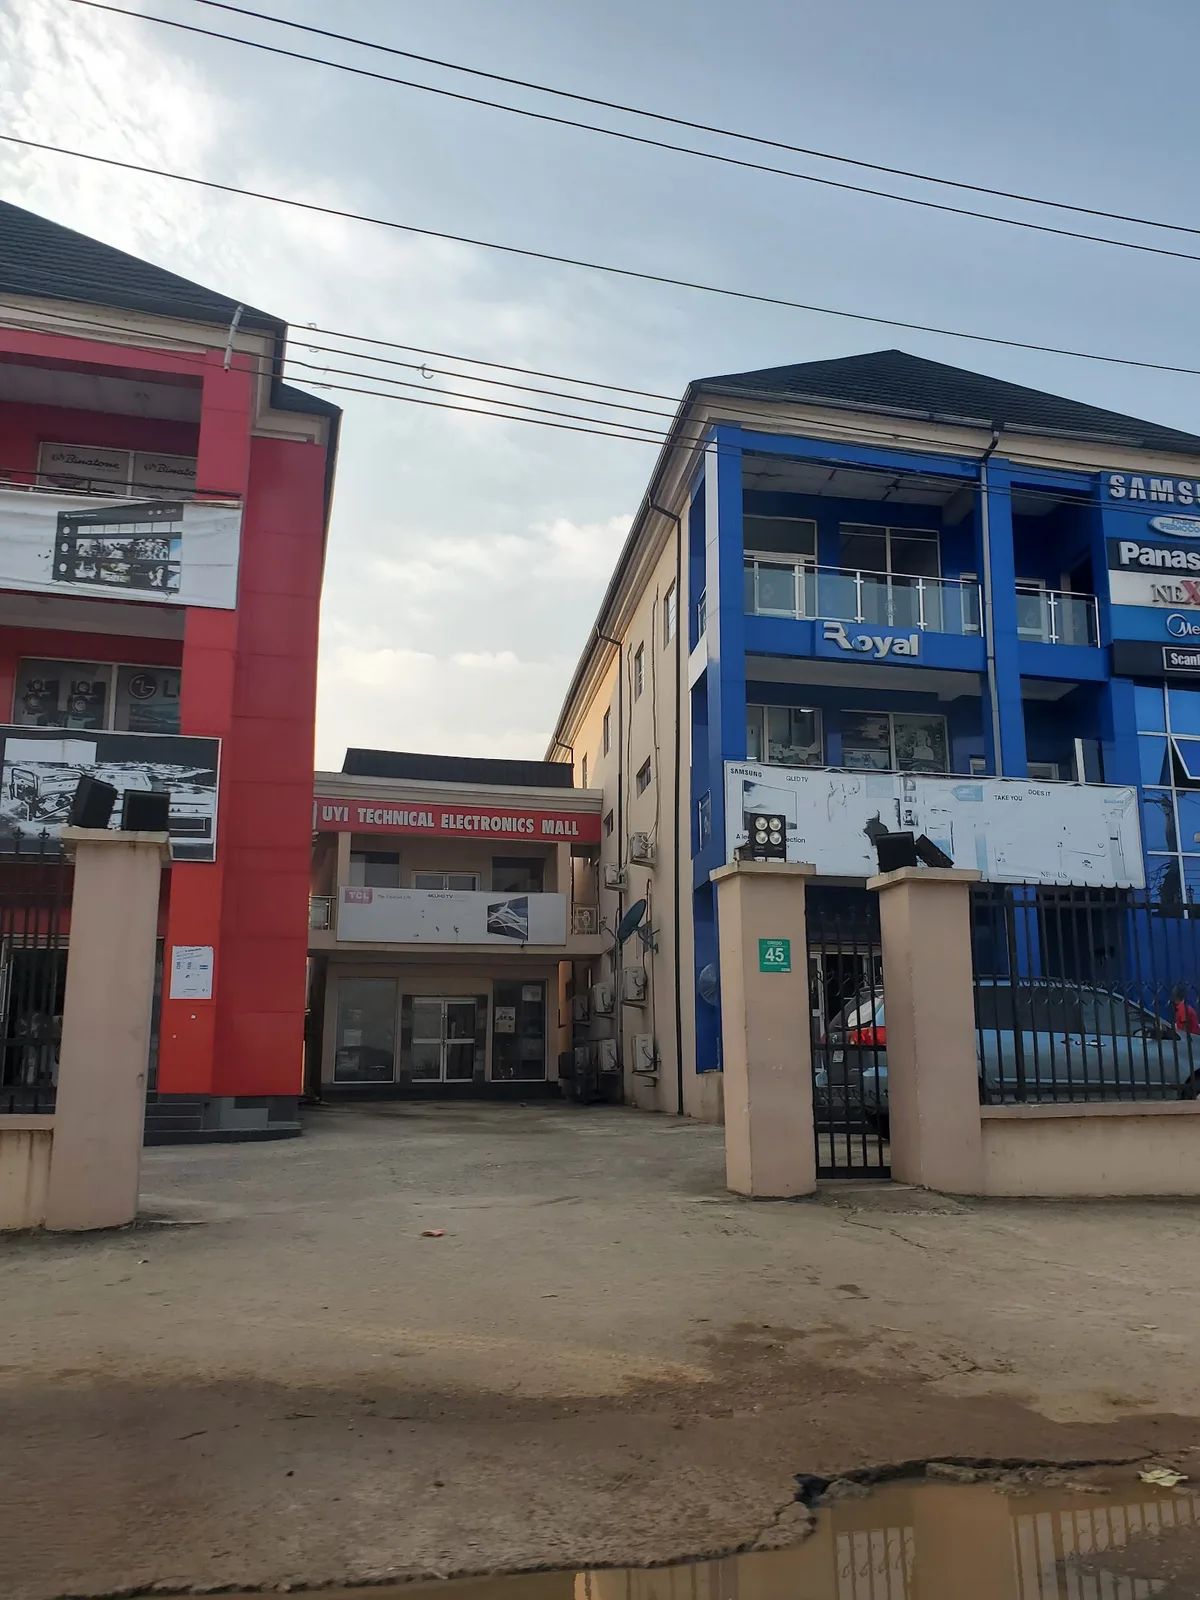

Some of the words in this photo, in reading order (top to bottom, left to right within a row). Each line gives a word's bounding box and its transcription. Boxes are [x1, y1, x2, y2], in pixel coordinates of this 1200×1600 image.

[65, 454, 120, 470] Binatone
[1119, 541, 1200, 571] Panas
[823, 621, 919, 658] Royal
[730, 768, 763, 778] SAMSUNG
[322, 806, 349, 822] UYI
[358, 808, 435, 828] TECHNICAL
[441, 814, 535, 834] ELECTRONICS
[541, 819, 579, 836] MALL
[1040, 871, 1068, 879] NEUS
[348, 891, 370, 900] TCL
[765, 947, 784, 962] 45
